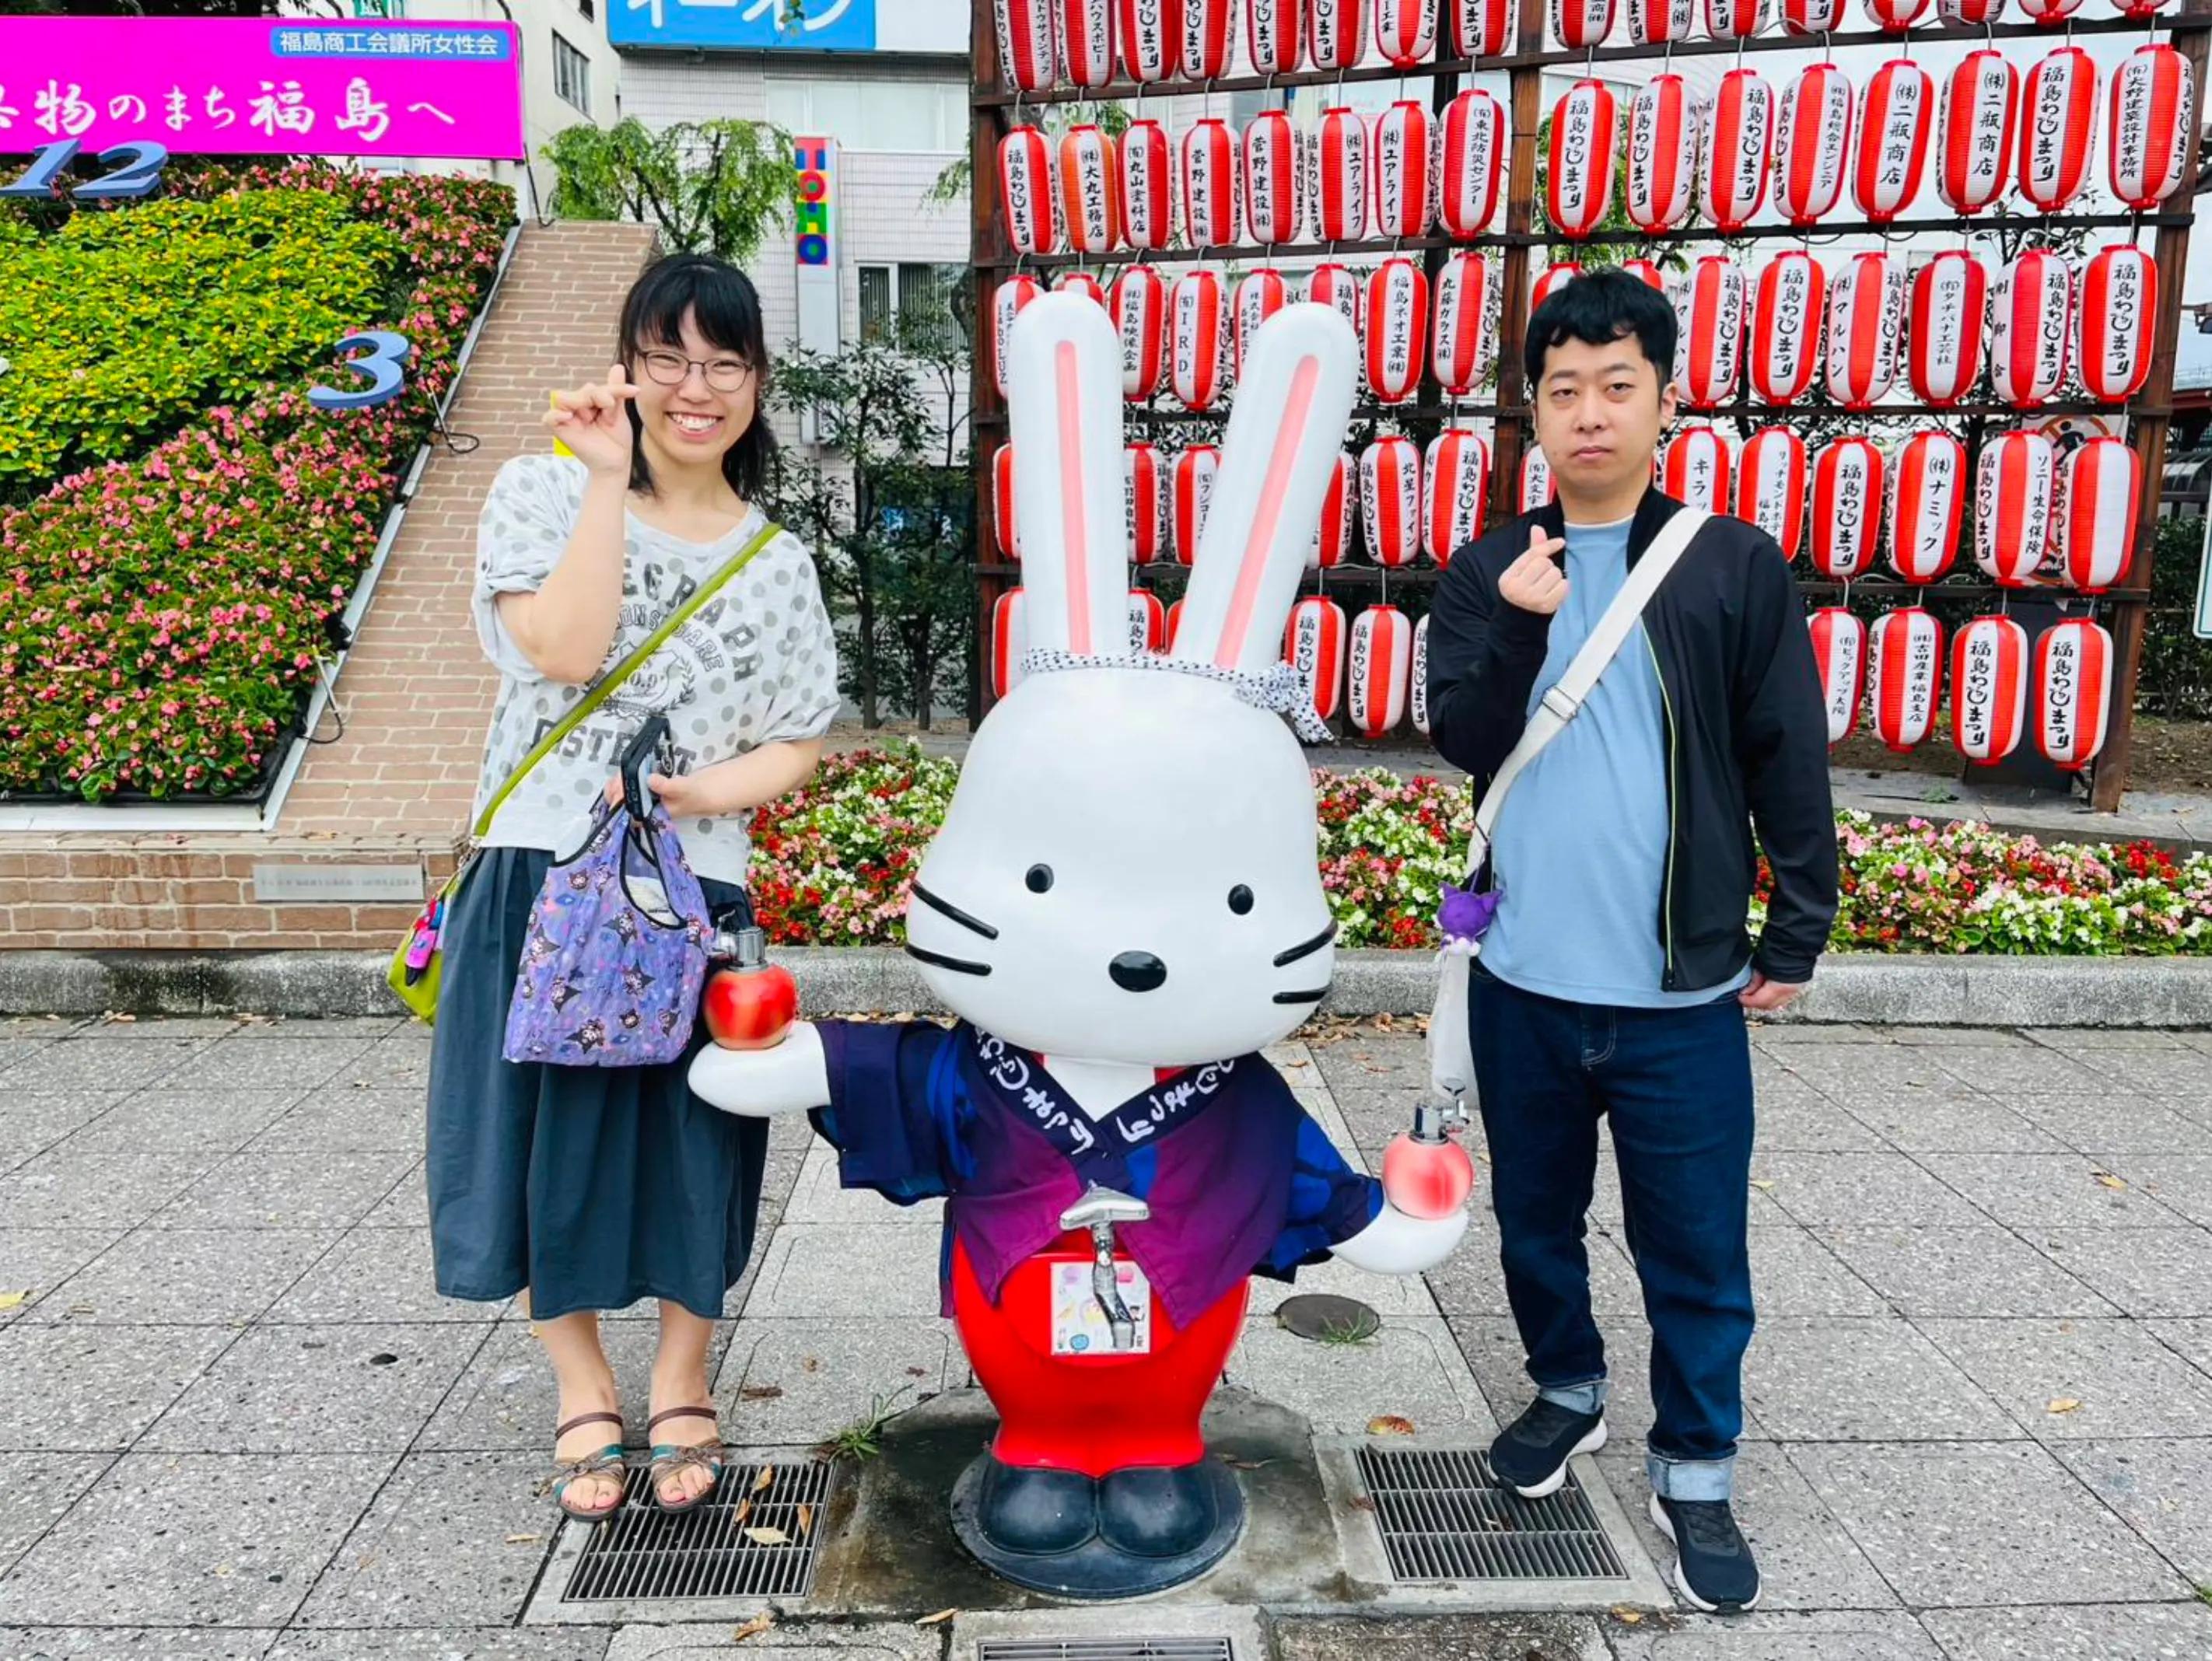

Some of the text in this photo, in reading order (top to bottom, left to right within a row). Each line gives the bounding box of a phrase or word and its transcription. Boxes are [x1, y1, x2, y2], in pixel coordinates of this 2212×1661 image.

[280, 32, 498, 55] 福島商工会議所女性会
[0, 138, 167, 198] 12
[1880, 82, 1918, 185] (株)二瓶商店
[1973, 71, 2005, 176] (株)二瓶商店
[307, 331, 410, 408] 3
[1923, 457, 1951, 551] (株)ナミック
[2025, 456, 2049, 555] ソニー生命保険
